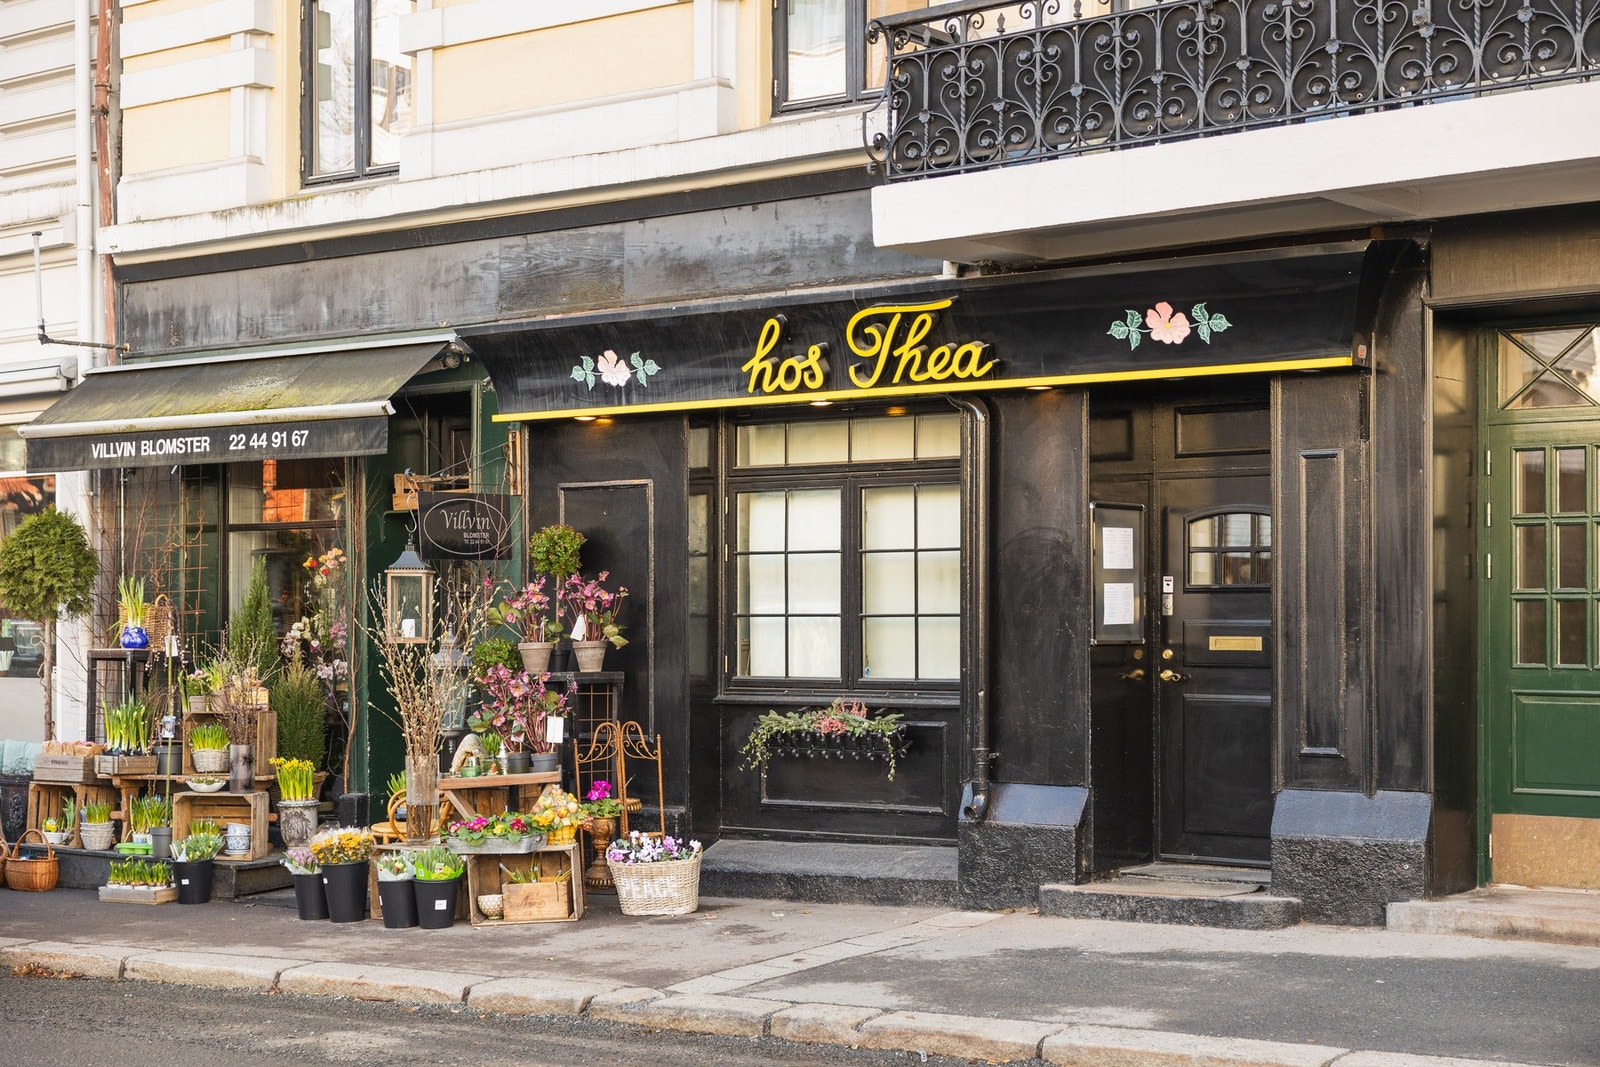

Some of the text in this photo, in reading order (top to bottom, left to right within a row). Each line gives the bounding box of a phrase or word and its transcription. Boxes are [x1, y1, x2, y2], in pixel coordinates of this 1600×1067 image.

[741, 299, 994, 393] hos Thea
[91, 430, 309, 459] VILLVIN BLOMSTER 22 44 91 67
[440, 509, 491, 530] Villvin
